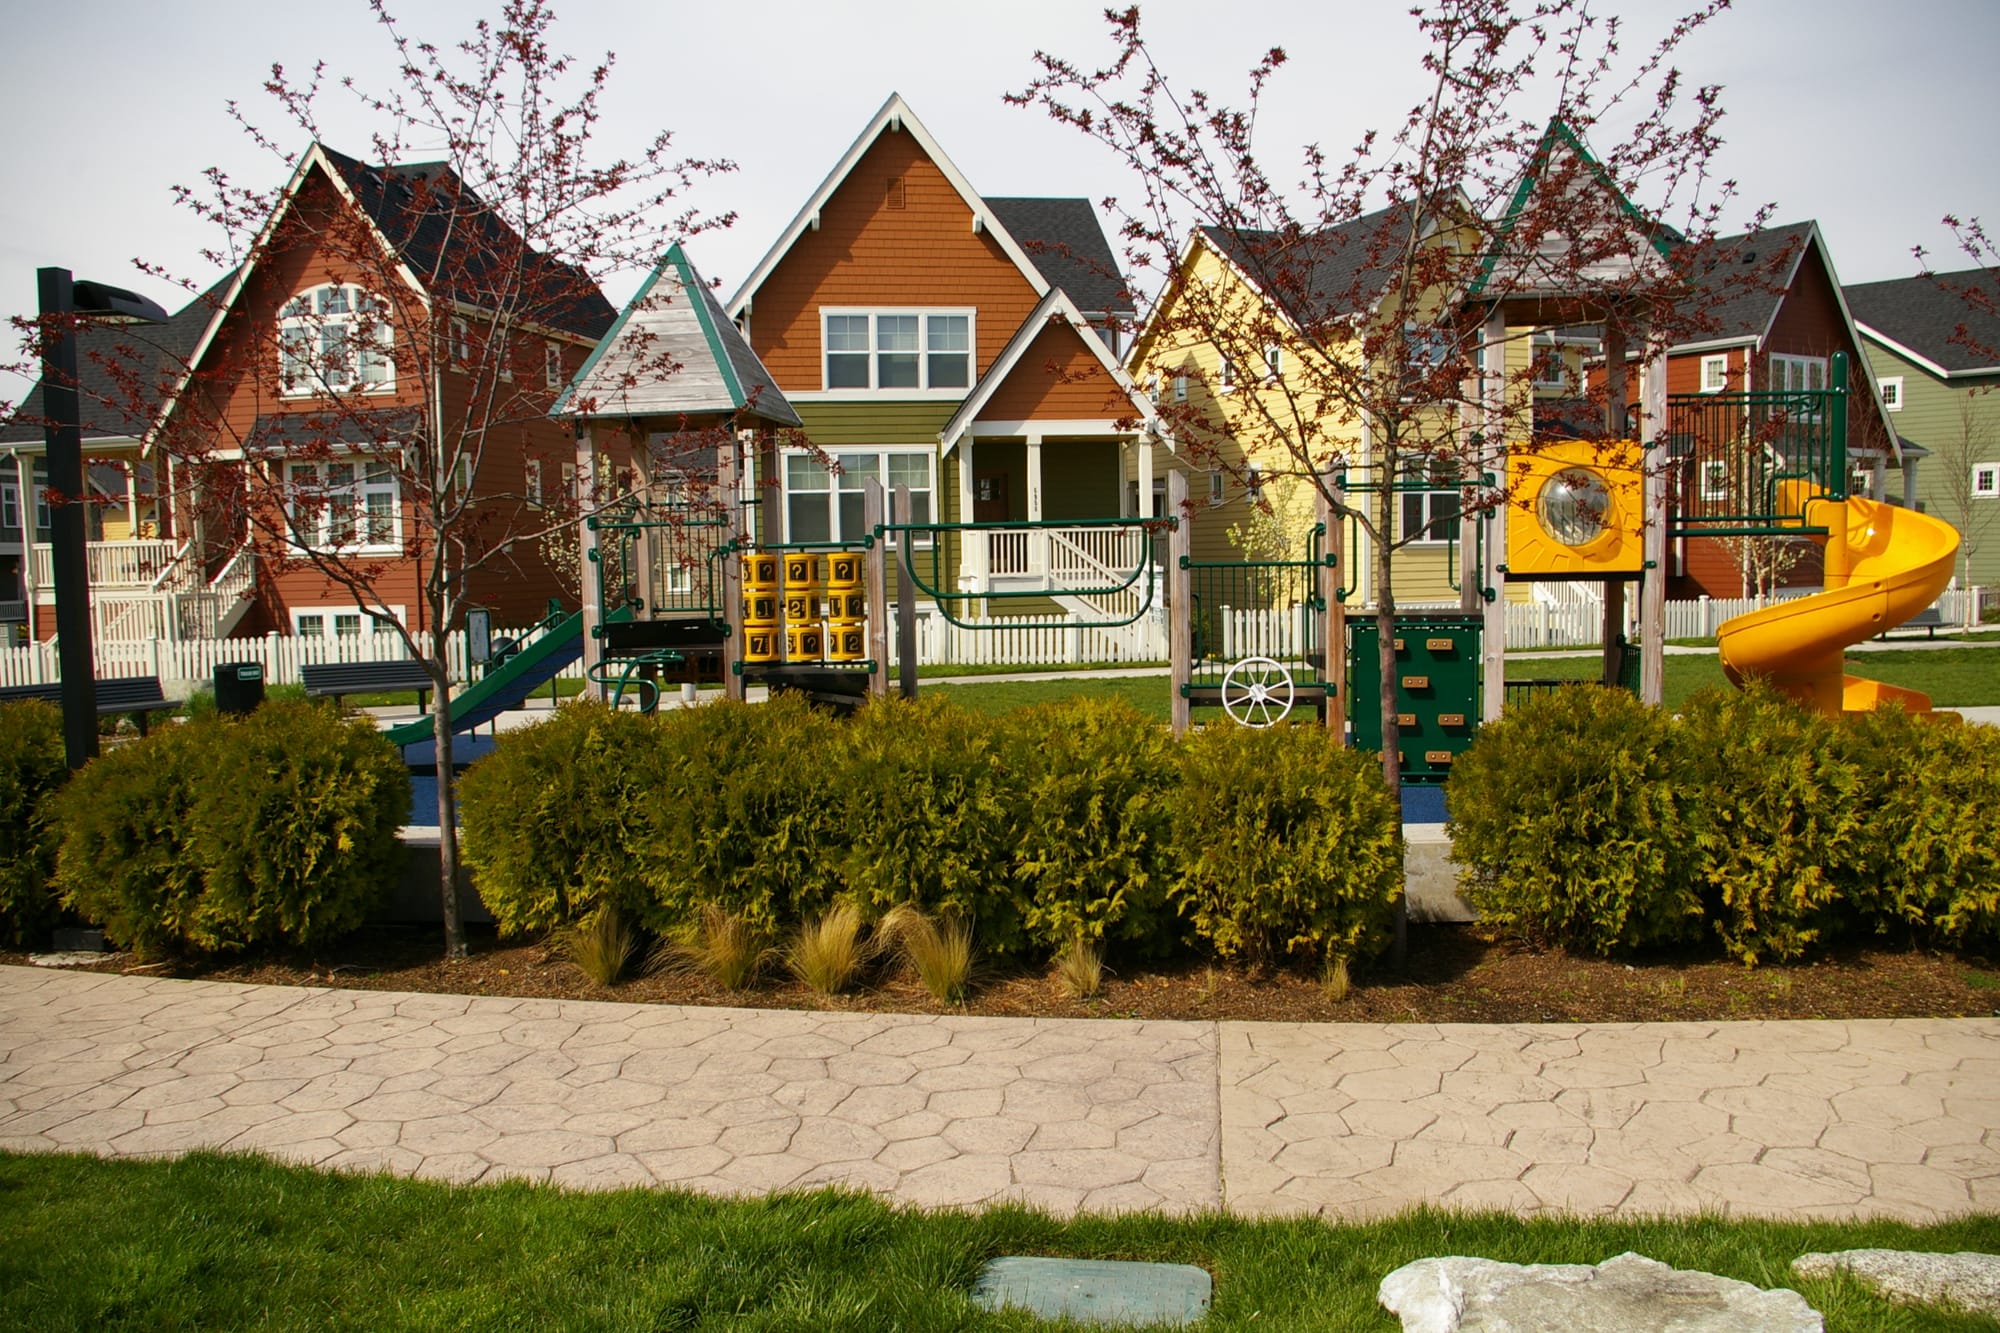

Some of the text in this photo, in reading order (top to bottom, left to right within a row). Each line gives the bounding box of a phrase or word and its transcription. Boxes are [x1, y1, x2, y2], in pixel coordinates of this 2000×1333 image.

[791, 601, 800, 617] 2
[753, 637, 764, 653] 7
[849, 636, 858, 651] 2
